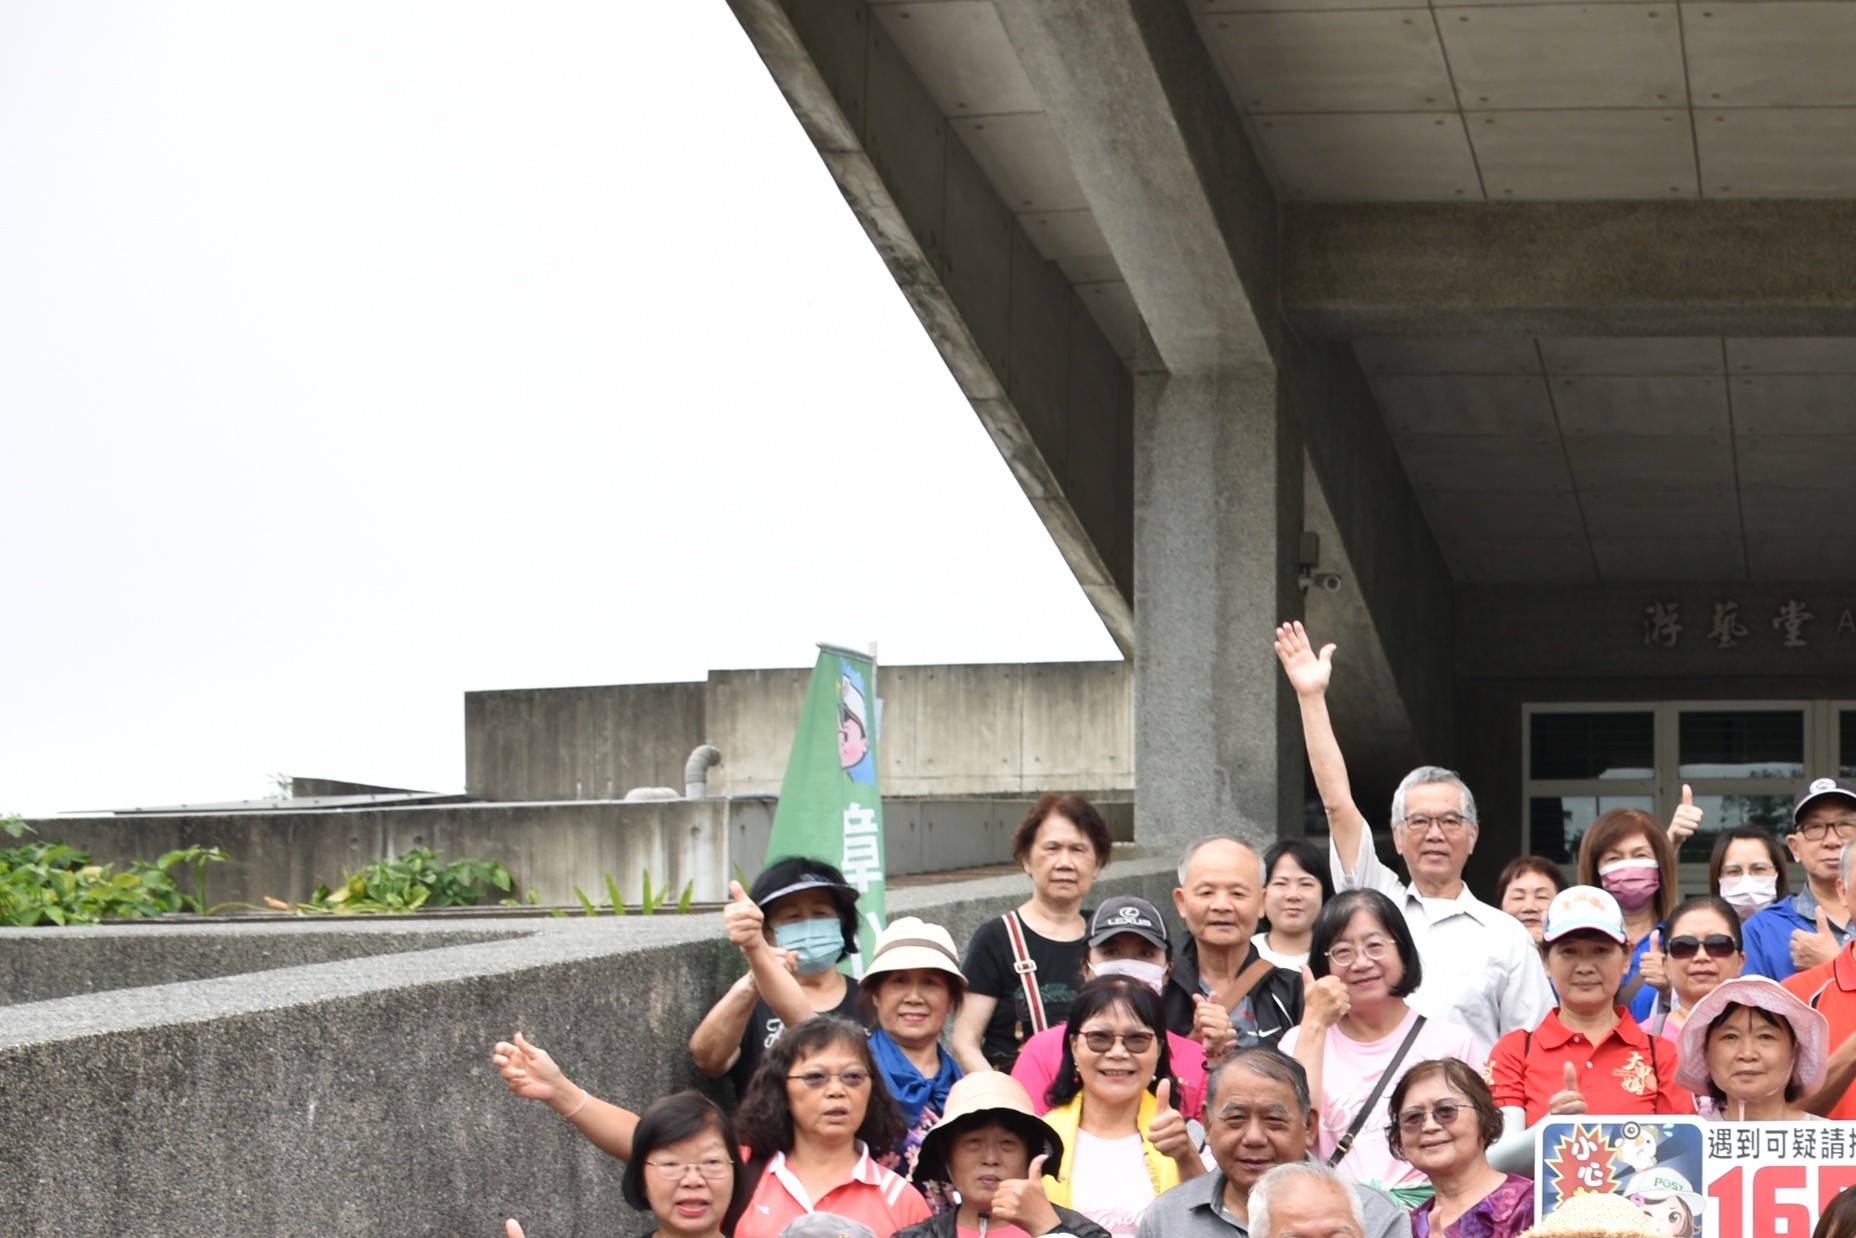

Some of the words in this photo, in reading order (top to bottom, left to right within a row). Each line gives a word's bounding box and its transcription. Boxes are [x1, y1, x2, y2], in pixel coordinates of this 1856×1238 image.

[1107, 917, 1152, 927] LEXUS
[1571, 1135, 1604, 1187] 小心
[1653, 1176, 1685, 1192] POST
